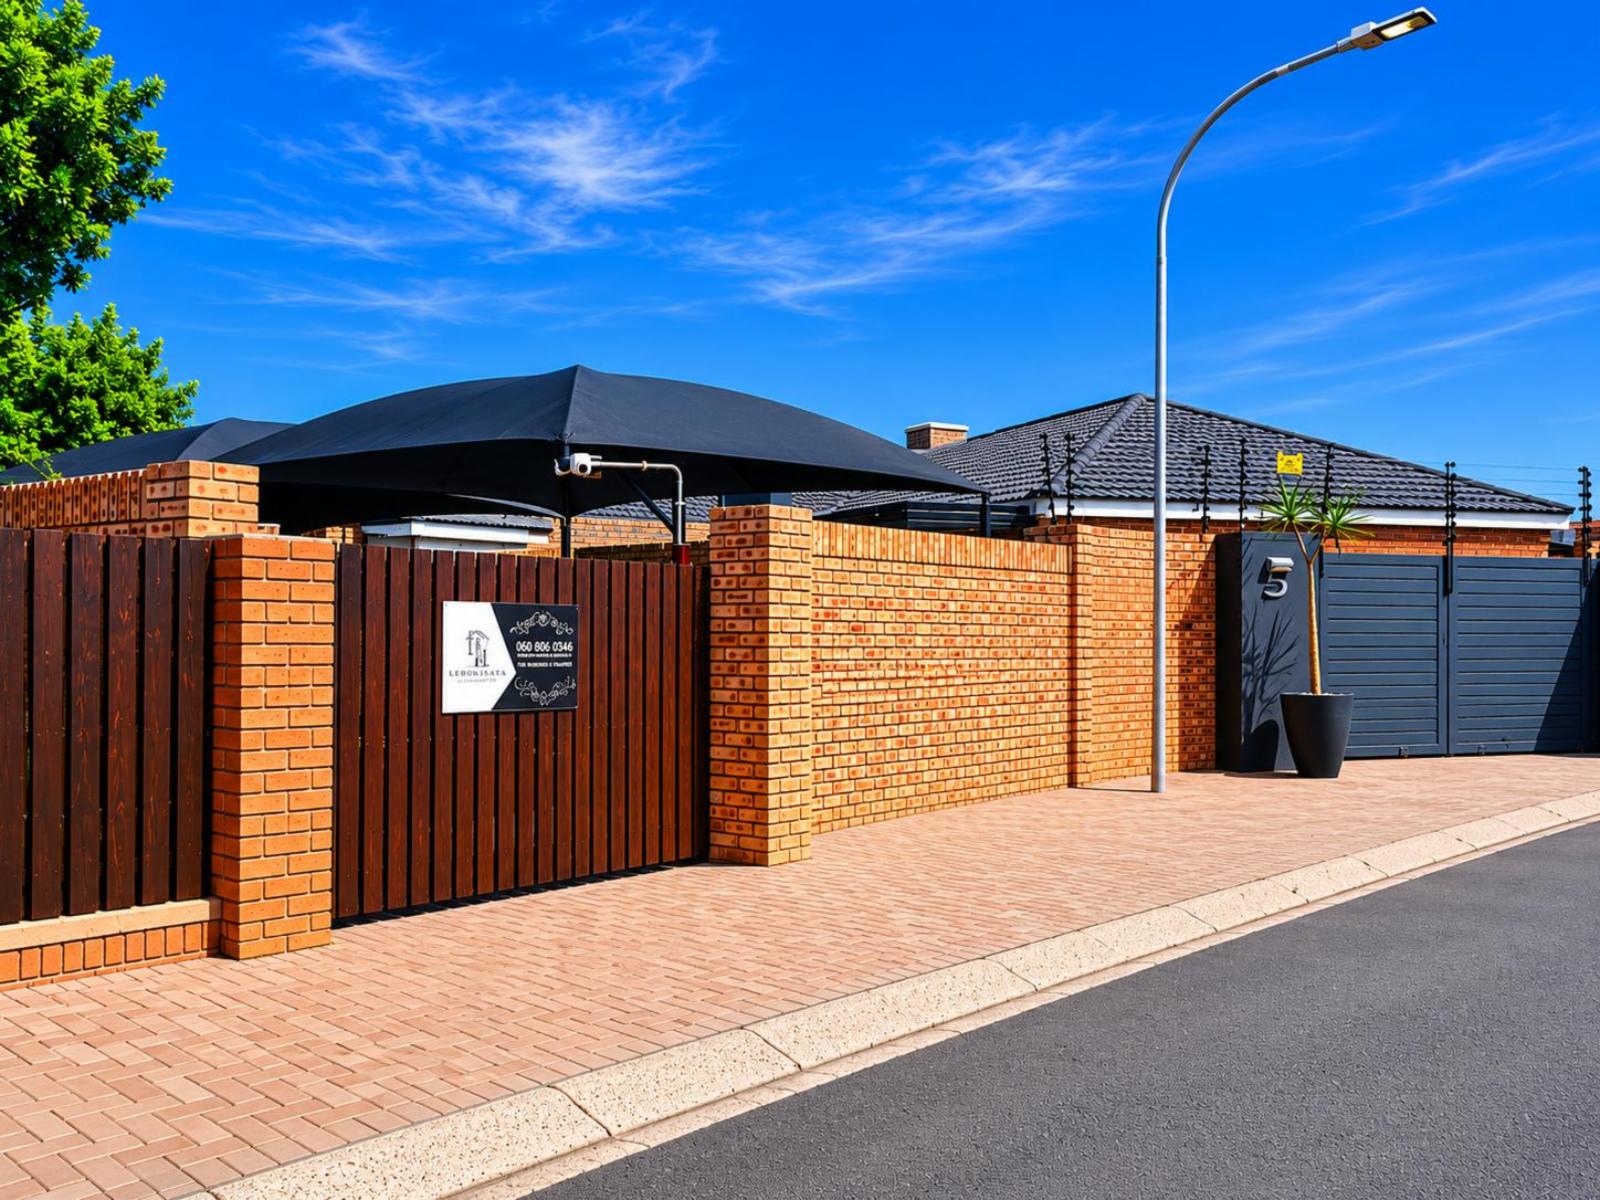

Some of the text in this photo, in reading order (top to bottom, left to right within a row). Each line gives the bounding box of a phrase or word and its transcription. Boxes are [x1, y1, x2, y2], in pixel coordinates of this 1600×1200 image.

[1263, 566, 1290, 598] 5
[516, 641, 573, 652] 060 806 0346
